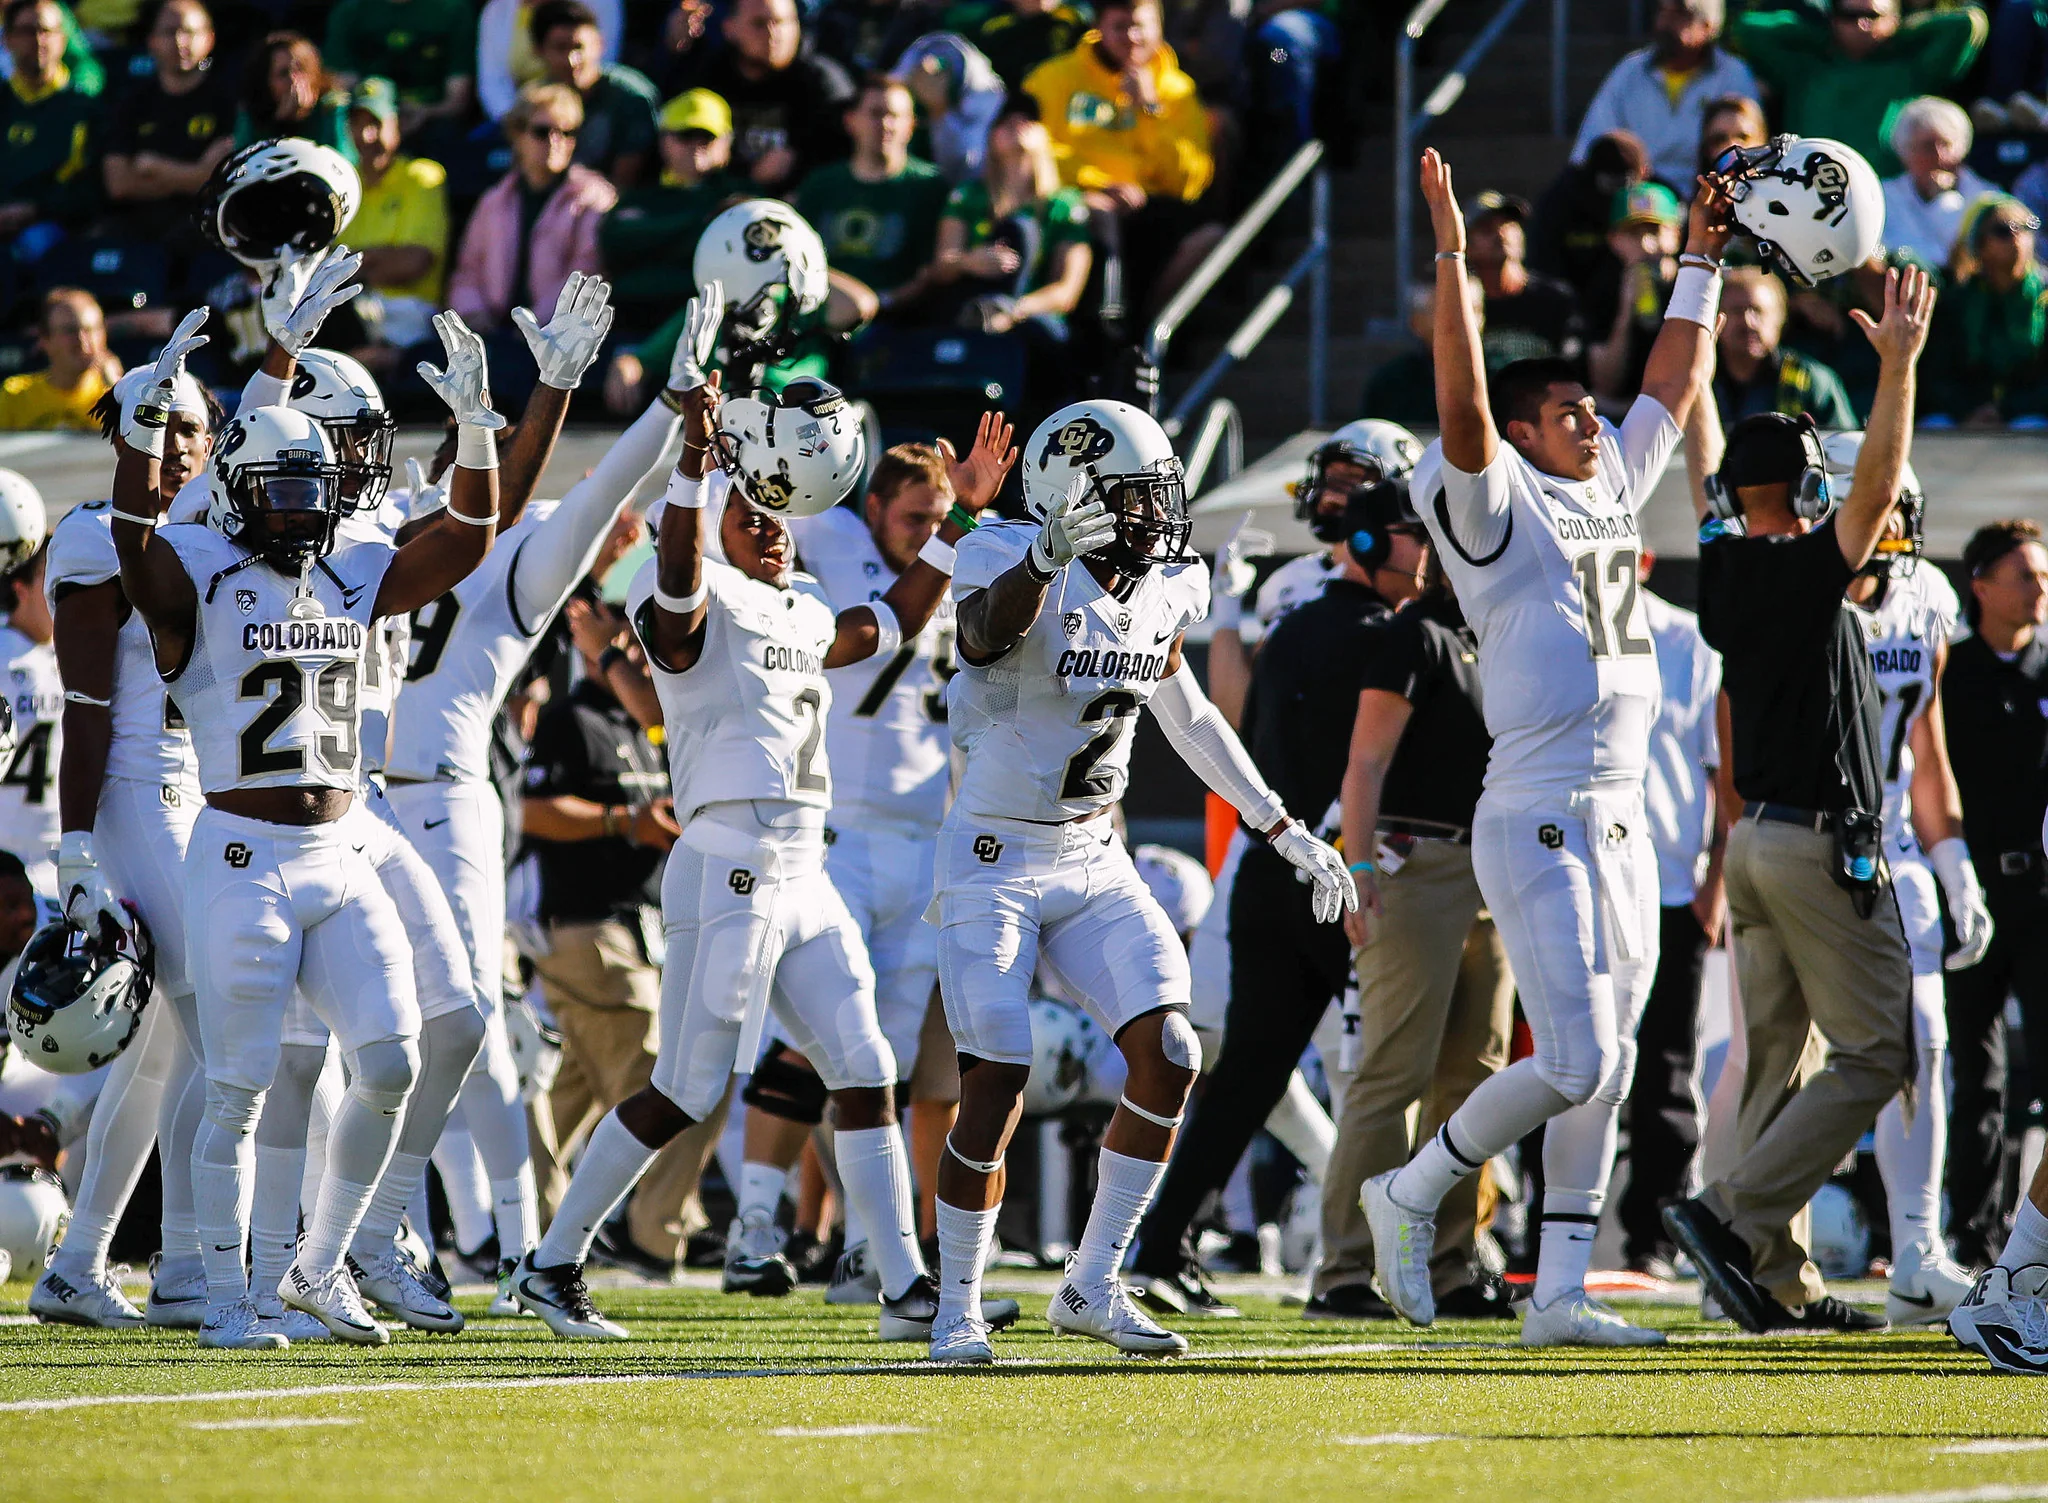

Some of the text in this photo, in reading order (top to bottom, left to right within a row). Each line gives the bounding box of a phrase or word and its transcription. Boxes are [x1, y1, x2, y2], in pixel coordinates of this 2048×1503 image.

[829, 416, 843, 436] 2
[1058, 423, 1095, 456] CU
[287, 450, 311, 460] BUFFS
[1557, 513, 1637, 541] COLORADO
[240, 600, 252, 612] 12
[1572, 547, 1652, 661] 12
[241, 622, 362, 651] COLORADO
[1065, 623, 1078, 635] 12
[1055, 649, 1164, 682] COLORADO
[236, 656, 360, 782] 29
[789, 686, 828, 793] 2
[1056, 686, 1139, 804] 2
[972, 833, 1004, 867] CU
[1538, 823, 1564, 850] CU
[223, 842, 253, 869] CU
[728, 868, 756, 895] CU
[43, 1272, 78, 1304] NIKE
[289, 1264, 311, 1295] NIKE
[1059, 1283, 1090, 1316] NIKE
